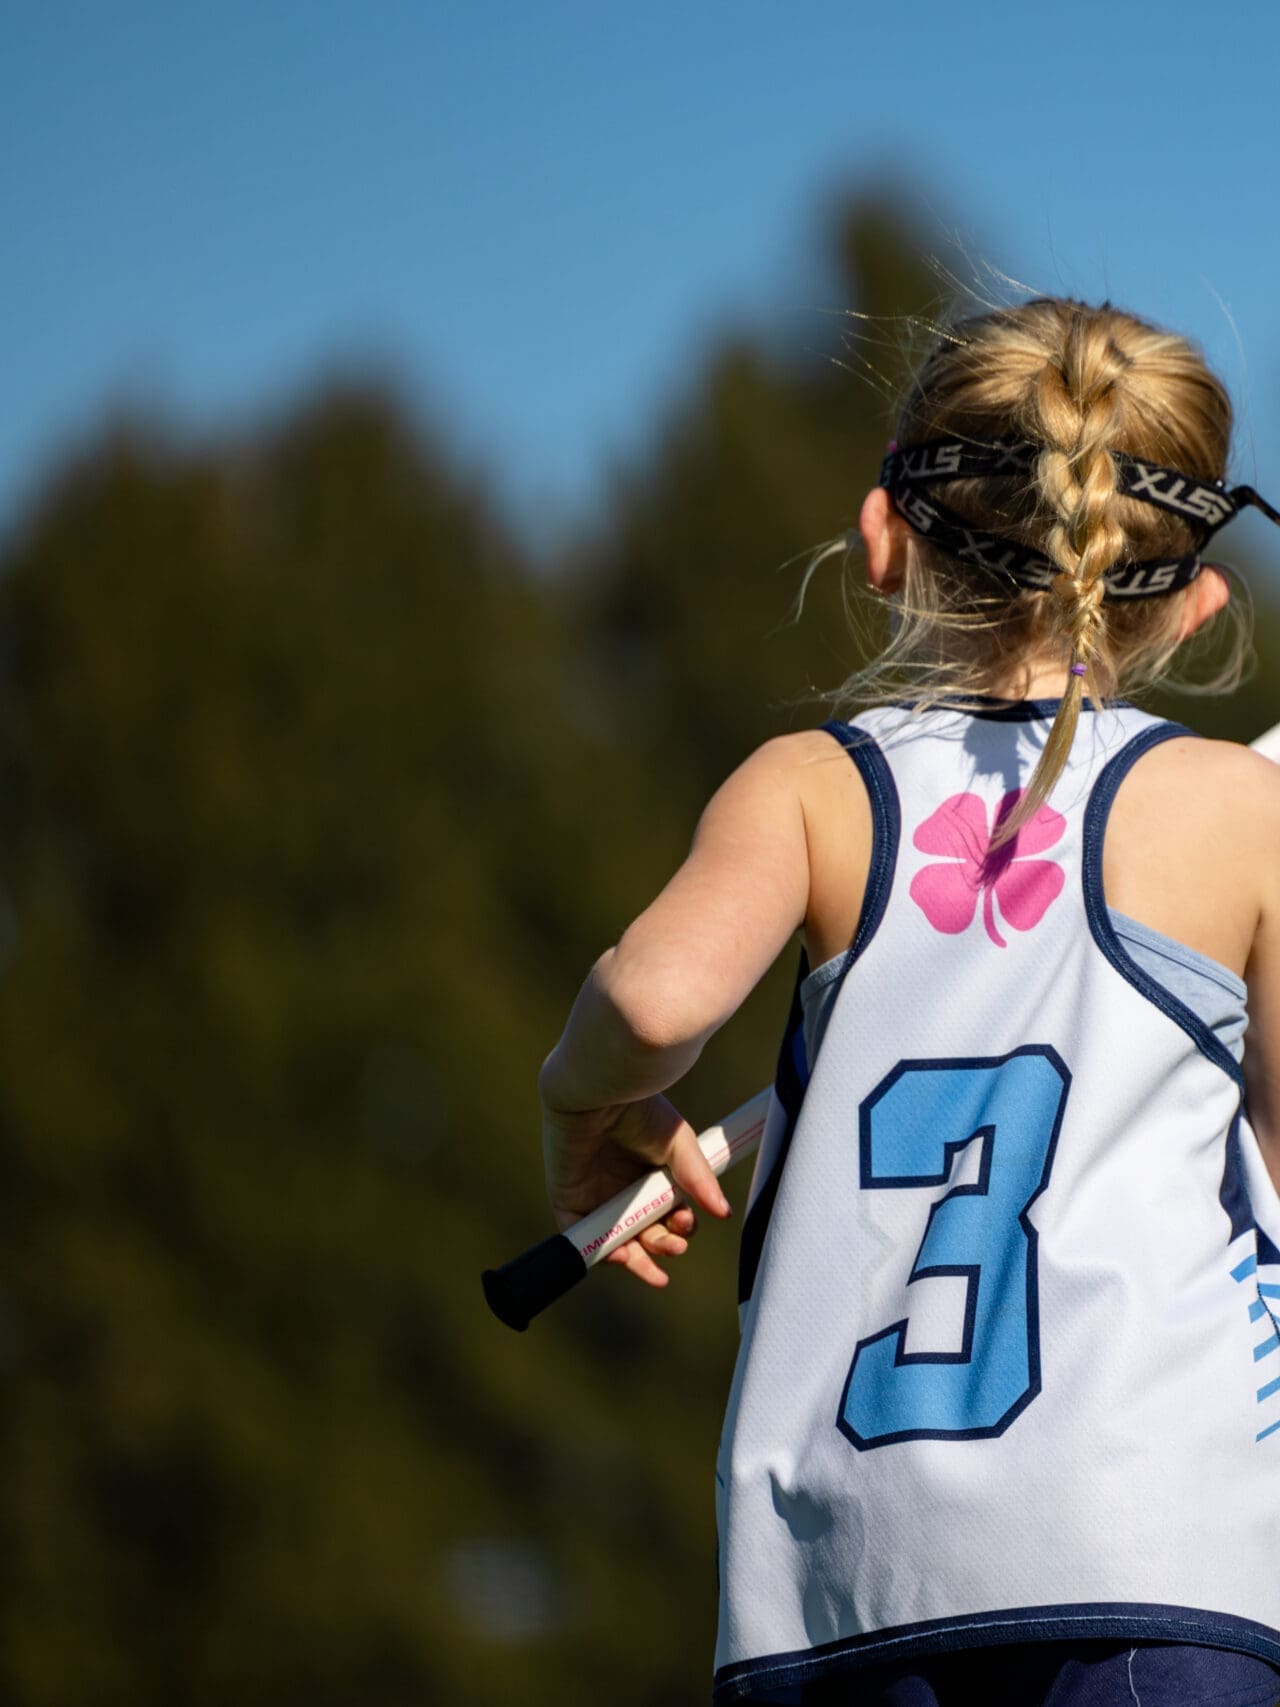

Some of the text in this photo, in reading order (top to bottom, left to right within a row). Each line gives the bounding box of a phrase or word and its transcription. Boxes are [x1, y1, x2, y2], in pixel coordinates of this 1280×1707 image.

[898, 443, 964, 481] STX
[896, 487, 936, 534] ST
[581, 1186, 677, 1257] IMUM OFFSET
[836, 1044, 1072, 1452] 3
